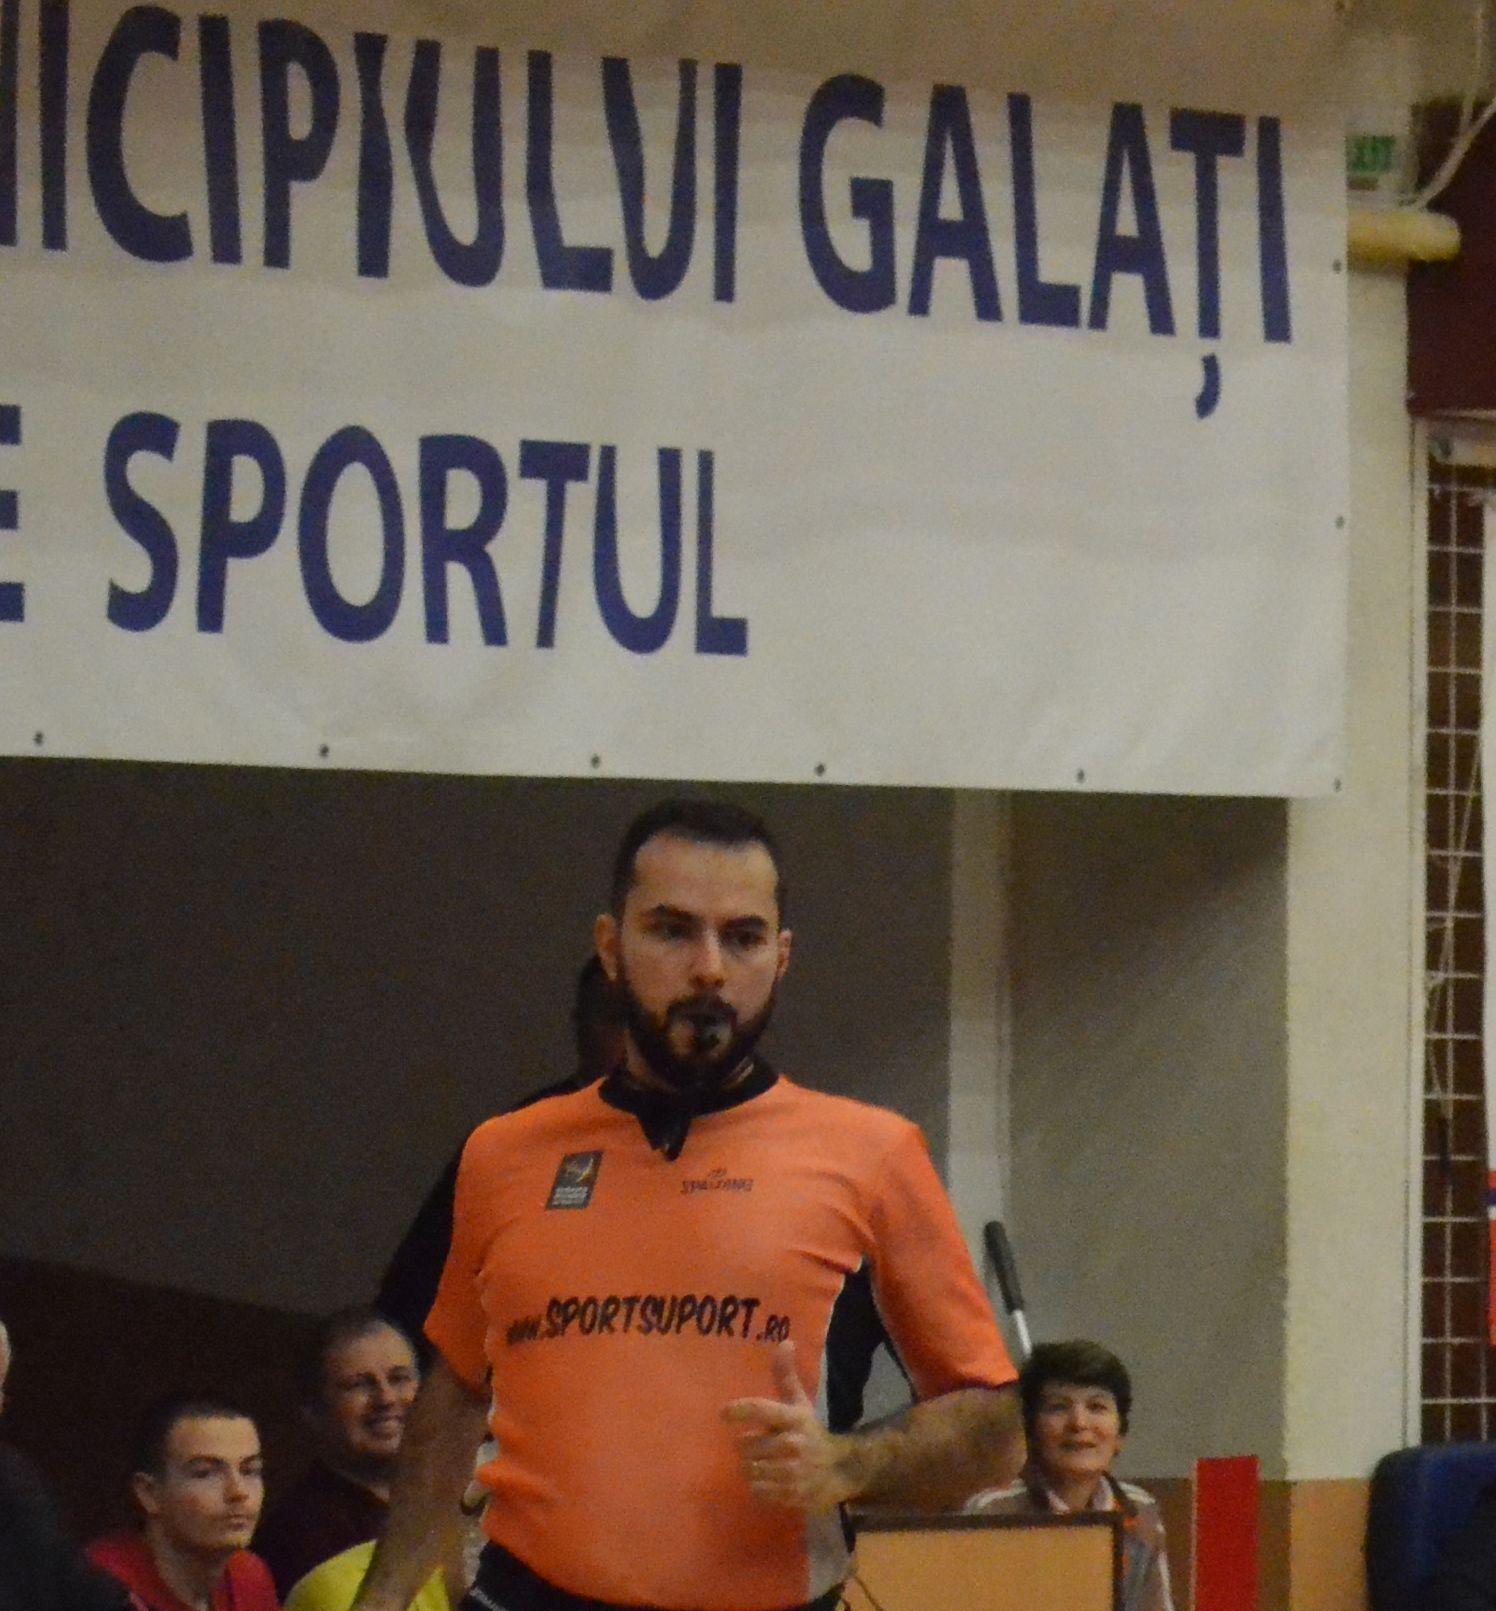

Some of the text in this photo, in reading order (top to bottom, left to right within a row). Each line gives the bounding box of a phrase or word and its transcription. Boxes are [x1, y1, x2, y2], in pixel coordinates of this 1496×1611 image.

[0, 0, 1292, 419] ICIPIULUI GALAȚI
[104, 411, 748, 656] SPORTUL
